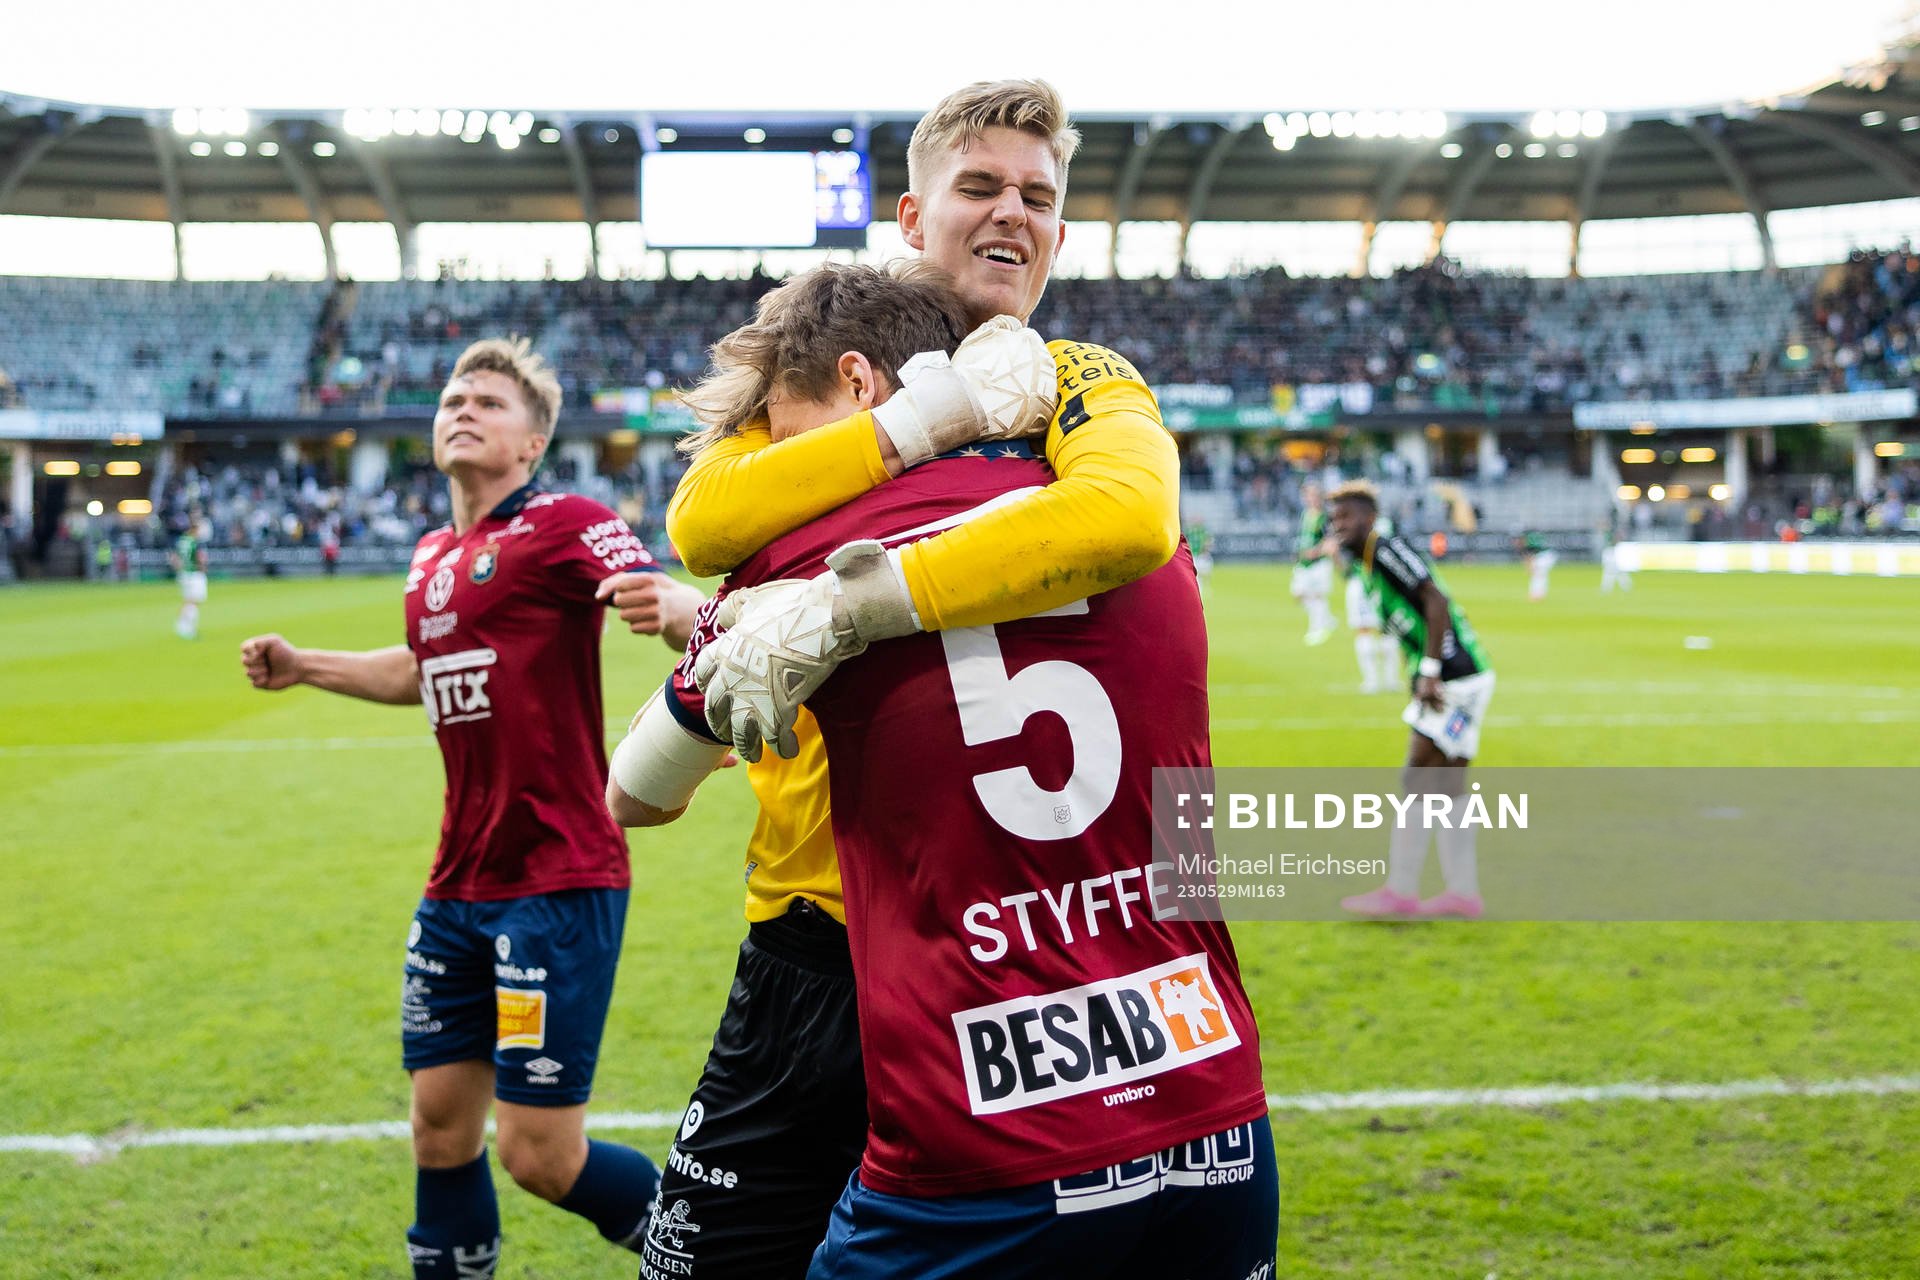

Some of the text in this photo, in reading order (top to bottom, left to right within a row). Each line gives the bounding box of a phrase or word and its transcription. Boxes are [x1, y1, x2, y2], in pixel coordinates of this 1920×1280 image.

[1057, 361, 1134, 398] tels
[940, 592, 1122, 841] 5
[962, 861, 1180, 963] STYFFE
[966, 988, 1168, 1103] BESAB
[1102, 1084, 1156, 1107] umbro
[1206, 1164, 1254, 1186] GROUP
